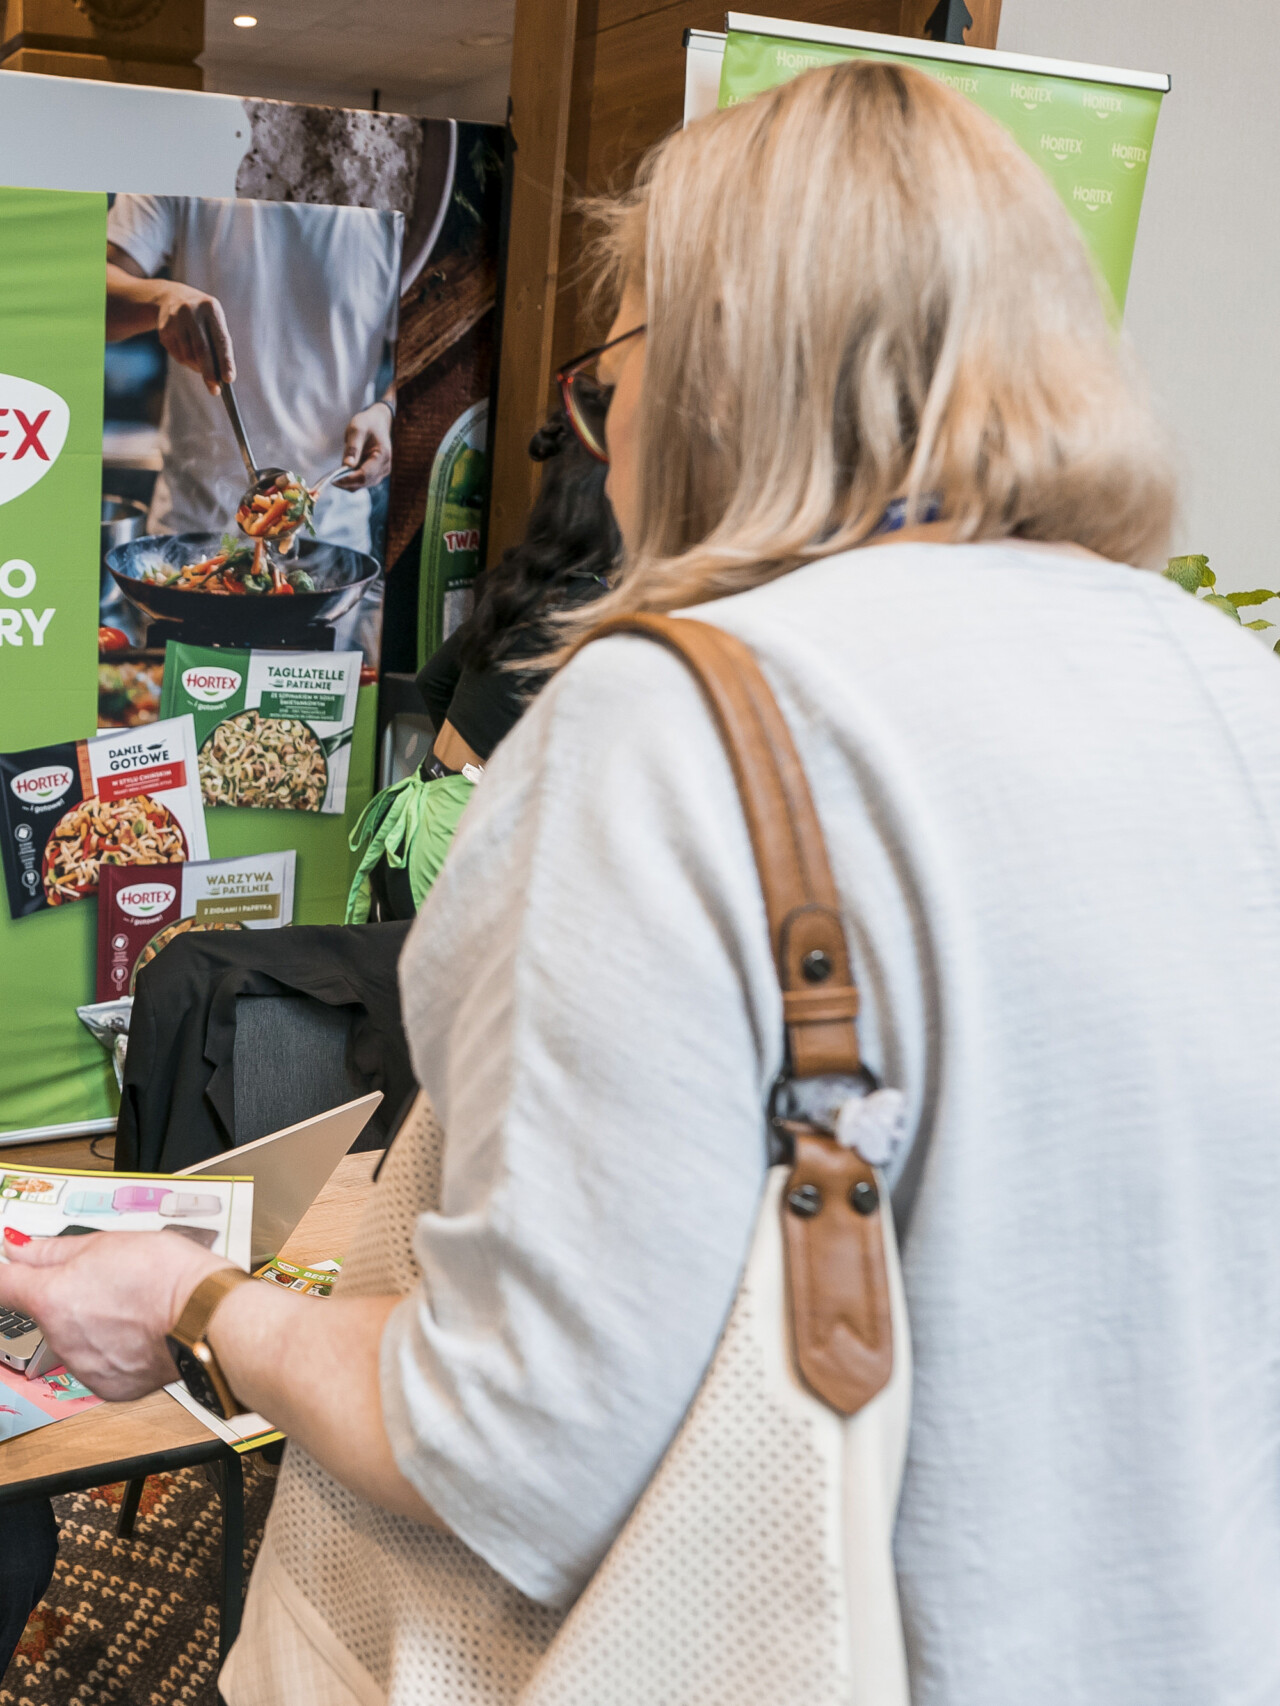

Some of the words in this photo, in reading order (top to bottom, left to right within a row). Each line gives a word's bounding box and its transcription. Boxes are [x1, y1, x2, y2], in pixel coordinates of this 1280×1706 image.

[1010, 82, 1053, 103] HORTEX
[1082, 91, 1123, 112] HORTEX
[1040, 134, 1083, 154] HORTEX
[1111, 142, 1148, 163] HORTEX
[1073, 185, 1113, 204] HORTEX
[186, 673, 238, 690] HORTEX
[268, 666, 345, 681] TAGLIATELLE
[286, 679, 332, 691] PATELNIĘ
[109, 744, 143, 759] DANIE
[110, 750, 170, 771] GOTOWE
[16, 772, 69, 794] HORTEX
[206, 872, 274, 886] WARZYWA
[121, 890, 171, 905] HORTEX
